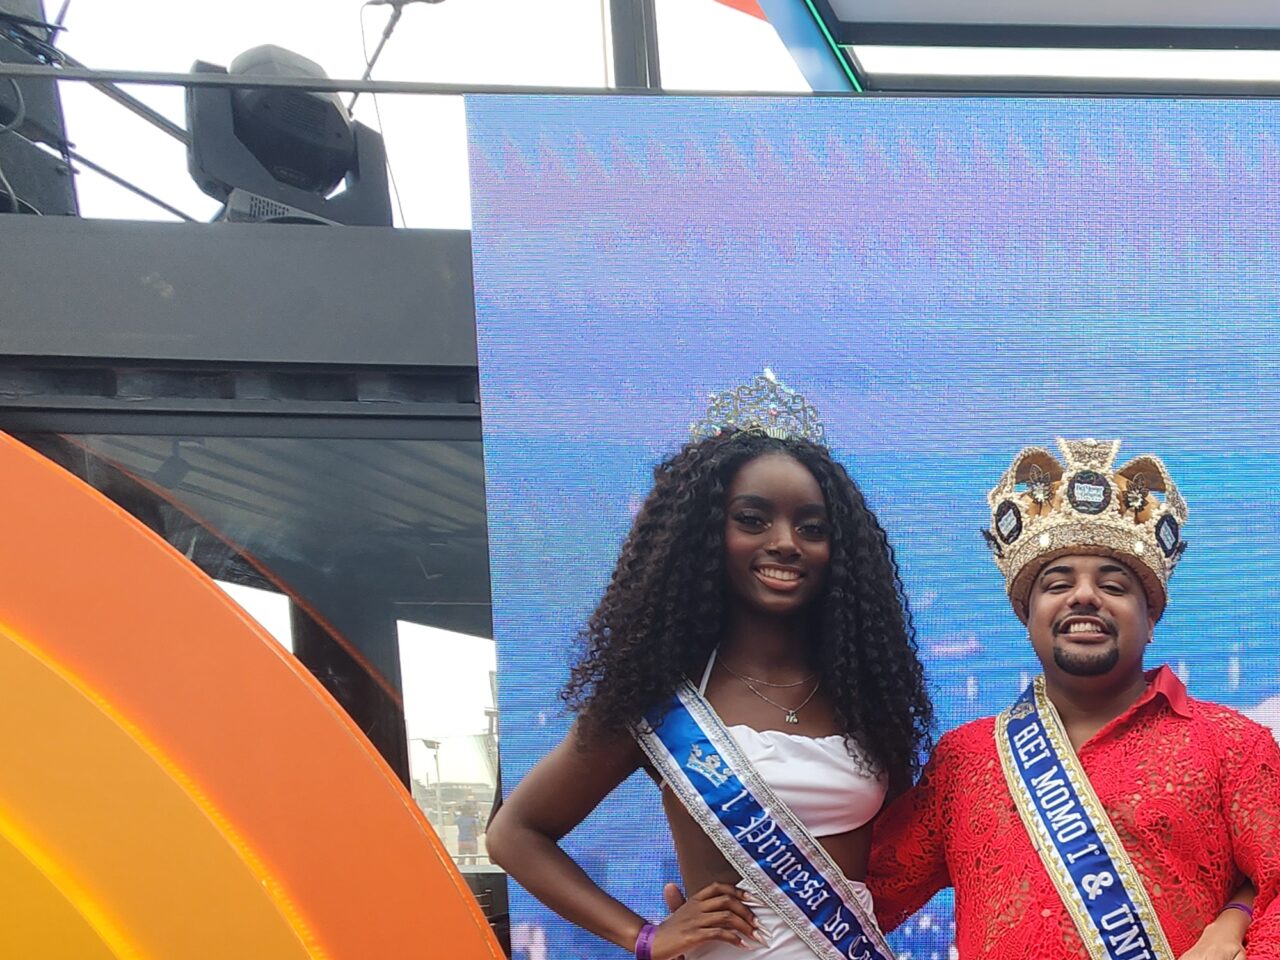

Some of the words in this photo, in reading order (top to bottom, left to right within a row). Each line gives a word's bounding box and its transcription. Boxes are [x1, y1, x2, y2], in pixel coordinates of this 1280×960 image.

[1013, 722, 1051, 770] REI
[1030, 765, 1088, 844] MOMO
[735, 807, 831, 911] Princesa
[823, 905, 850, 941] do
[1081, 871, 1114, 900] &
